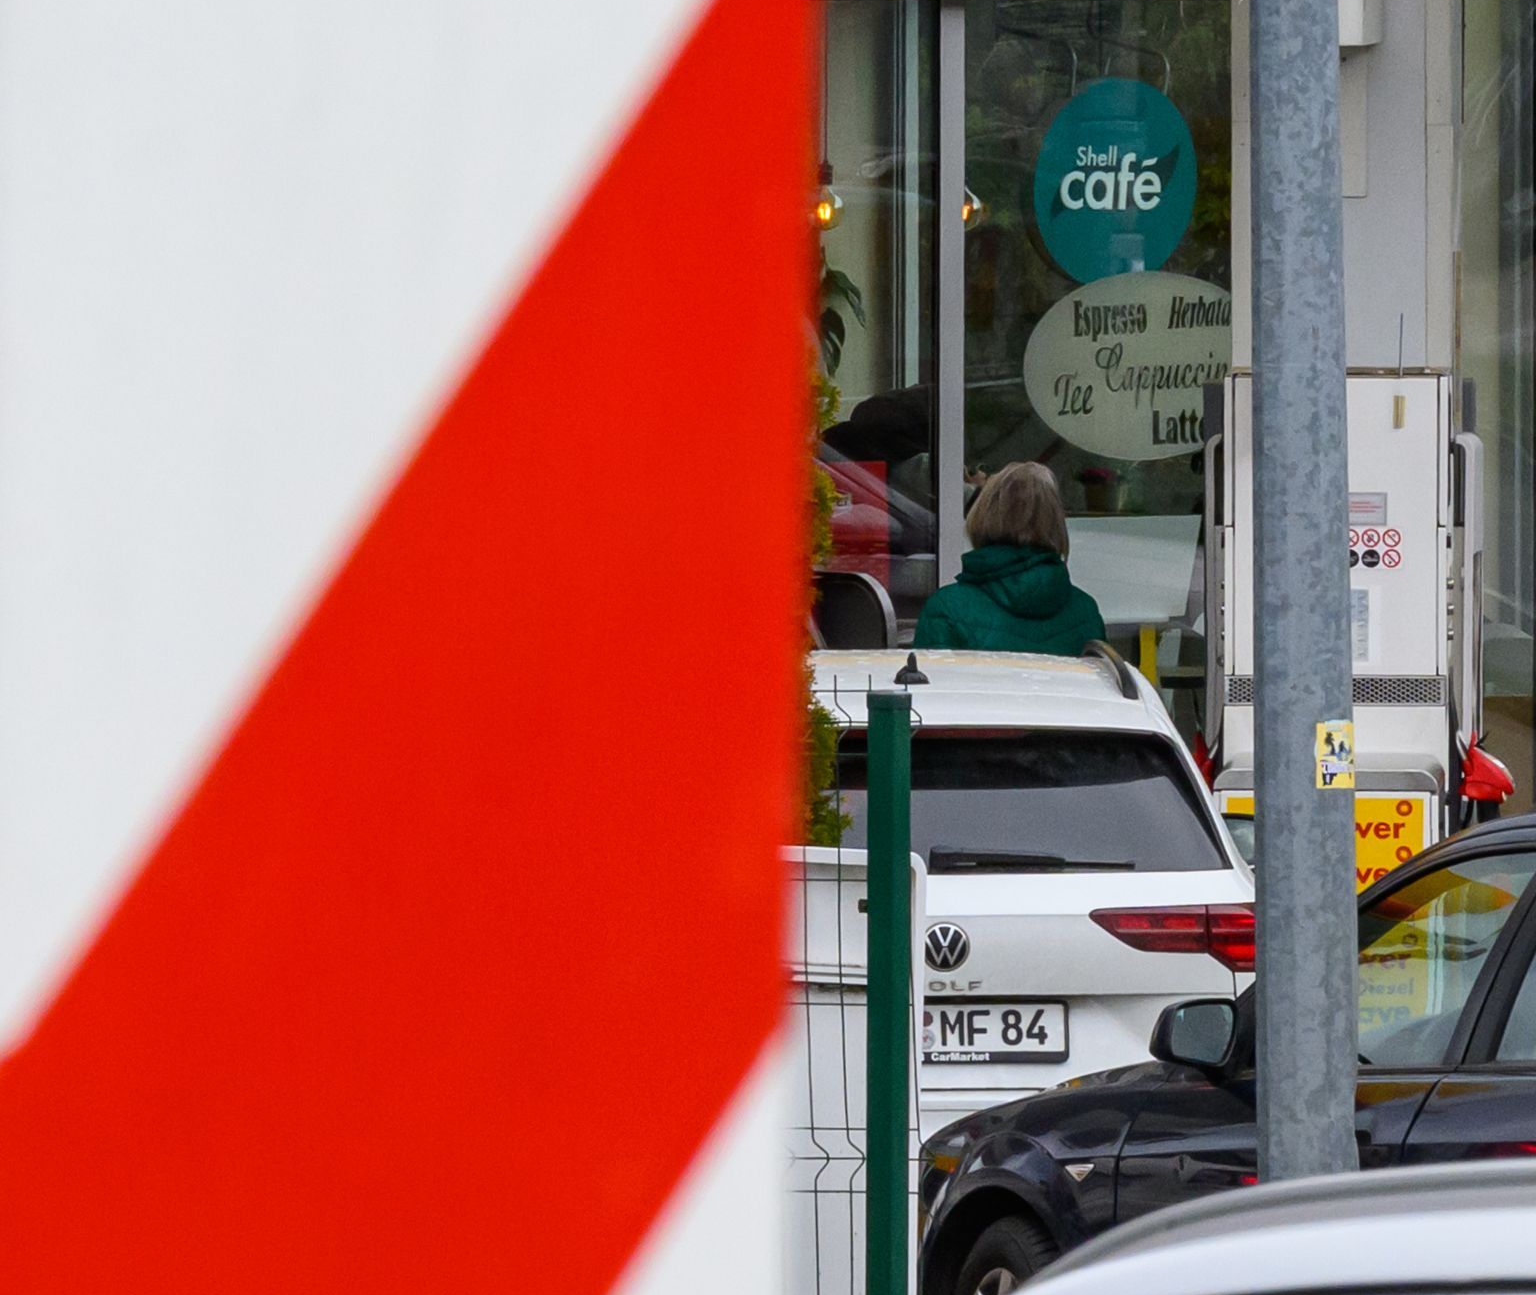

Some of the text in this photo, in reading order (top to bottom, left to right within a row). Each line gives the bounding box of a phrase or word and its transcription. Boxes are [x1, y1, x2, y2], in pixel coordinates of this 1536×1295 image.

[1076, 146, 1117, 166] Shell
[1060, 153, 1162, 211] café
[1073, 296, 1232, 342] Espresso Herbata
[1054, 373, 1094, 417] Tee
[940, 1009, 1049, 1047] MF 84
[930, 1052, 991, 1062] CarMarket
